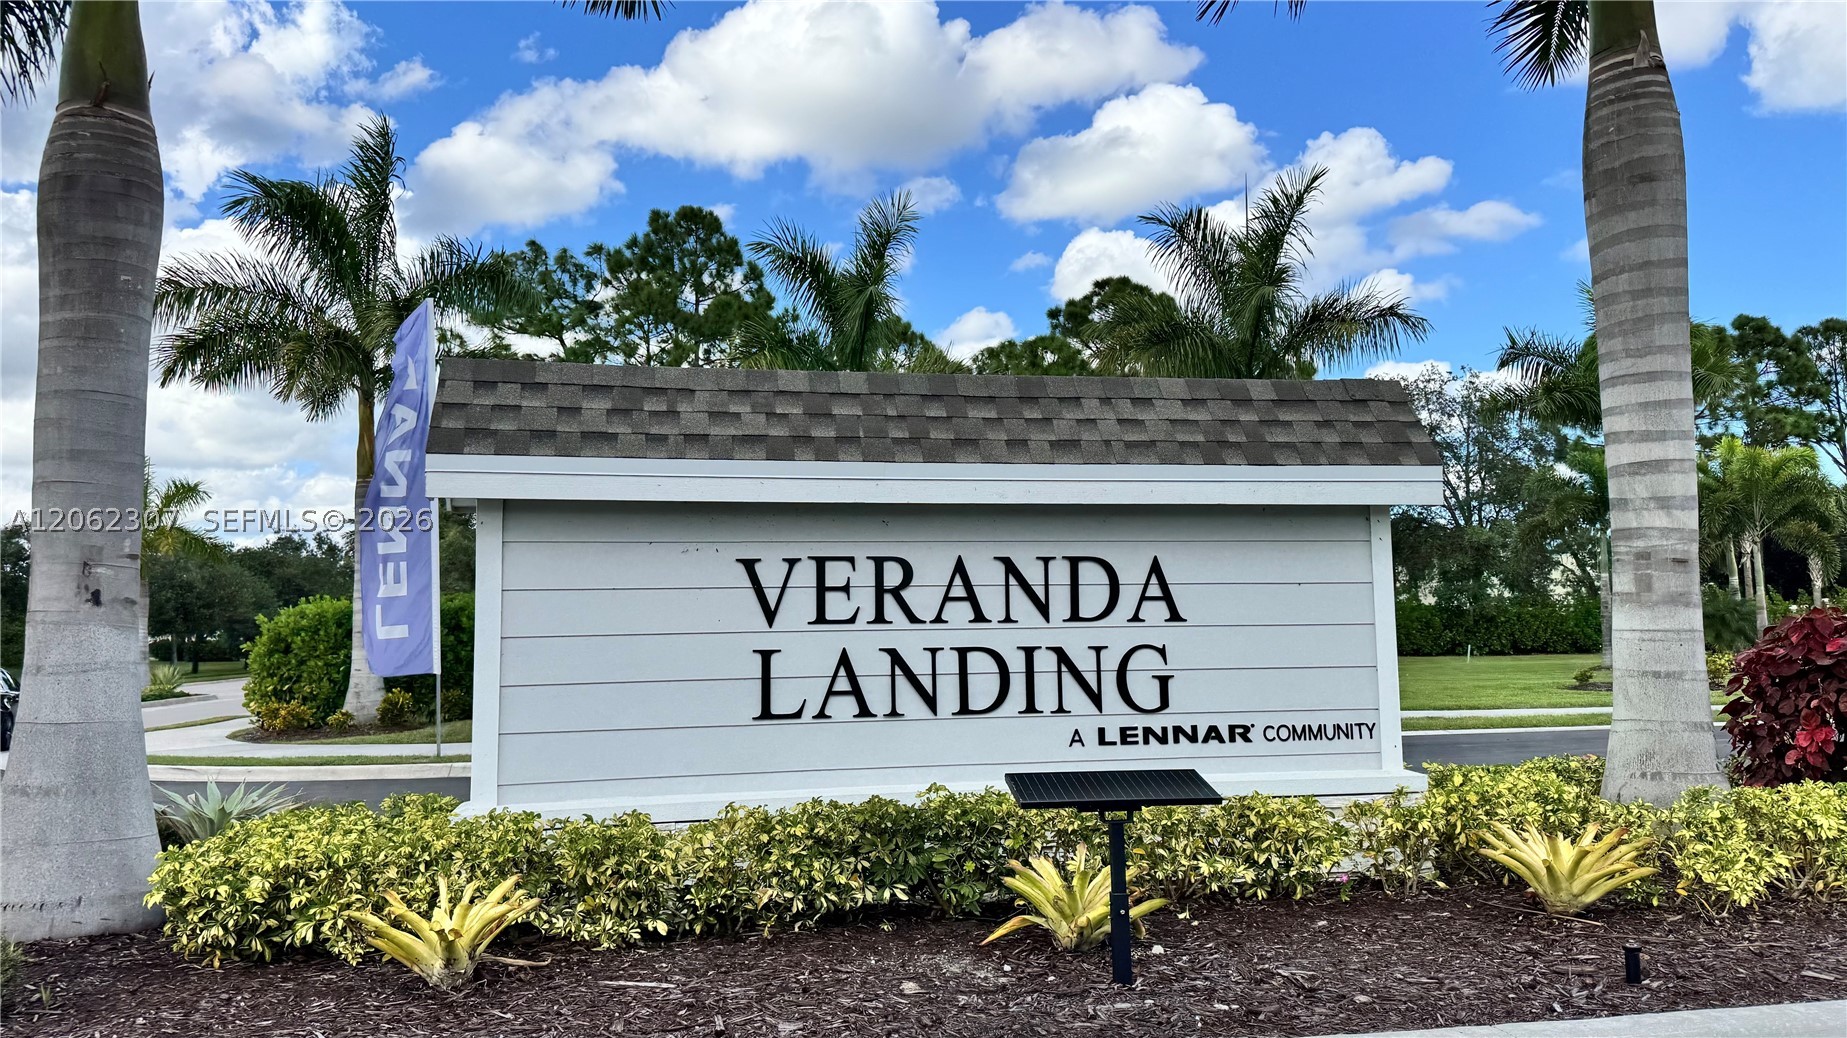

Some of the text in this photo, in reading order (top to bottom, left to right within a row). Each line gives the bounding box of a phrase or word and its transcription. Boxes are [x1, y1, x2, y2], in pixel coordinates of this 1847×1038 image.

[736, 555, 1187, 629] VERANDA
[752, 643, 1174, 720] LANDING
[1069, 728, 1085, 748] A
[1263, 722, 1377, 743] COMMUNITY
